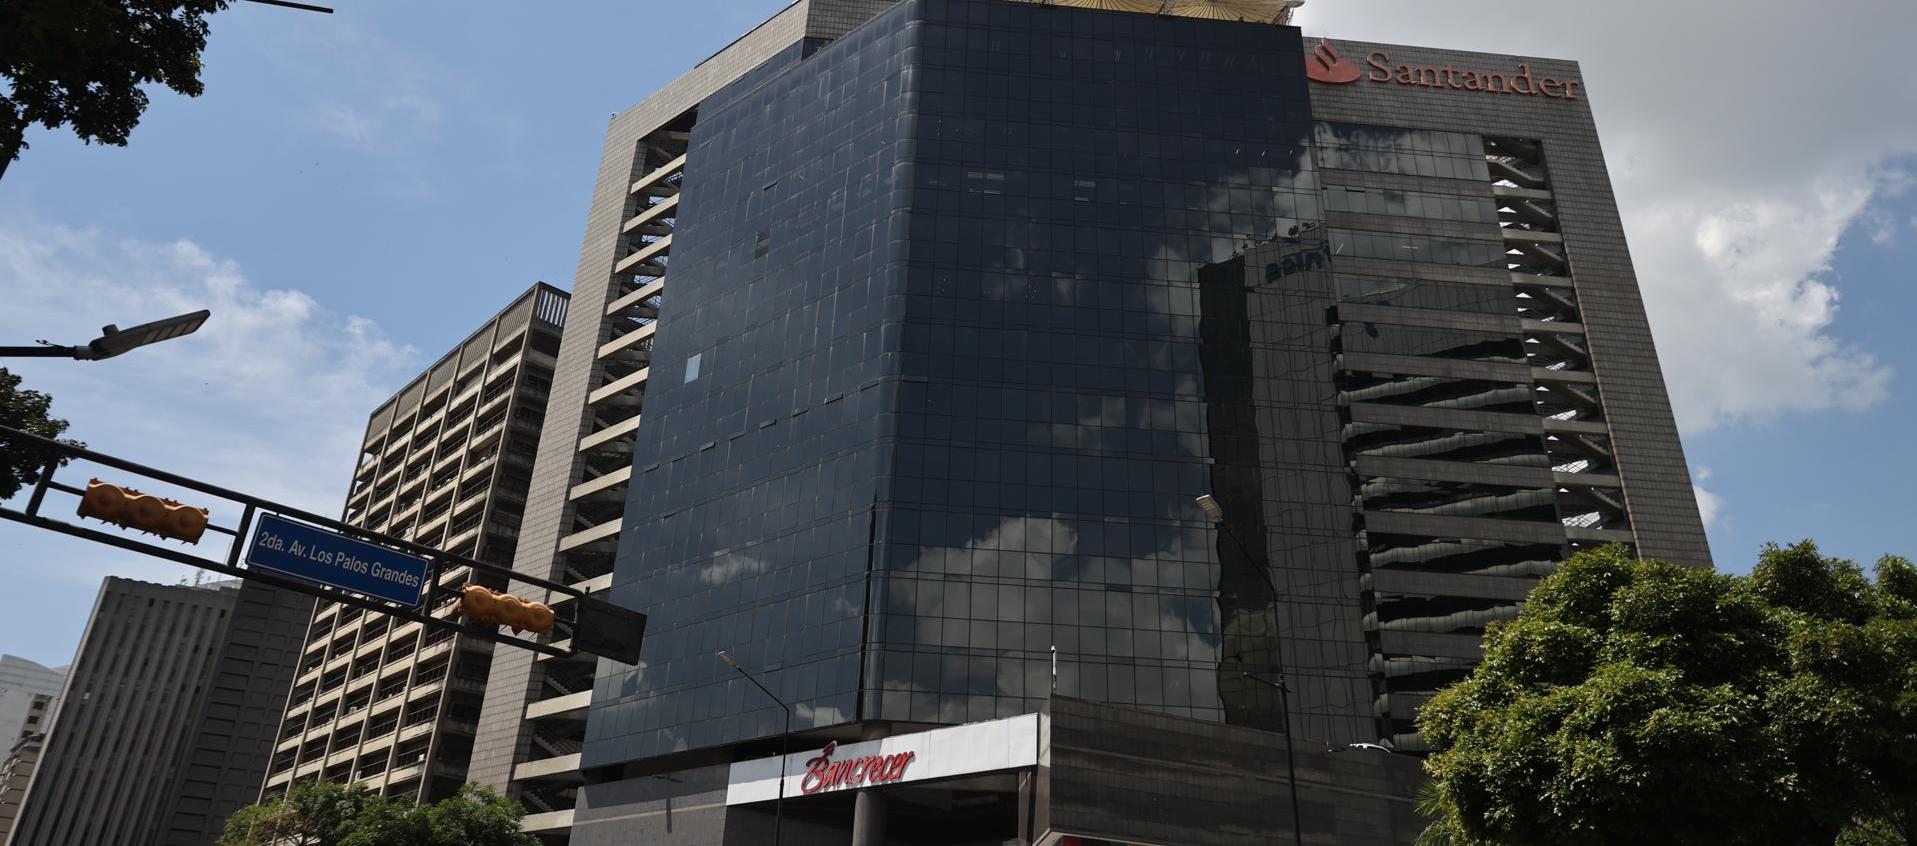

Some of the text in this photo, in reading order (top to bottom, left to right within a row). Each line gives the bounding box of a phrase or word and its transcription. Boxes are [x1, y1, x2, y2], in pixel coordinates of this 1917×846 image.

[1366, 51, 1579, 100] Santander
[258, 531, 420, 588] 2da. Av. Los Palos Grandes
[801, 741, 915, 793] Bancrecer
